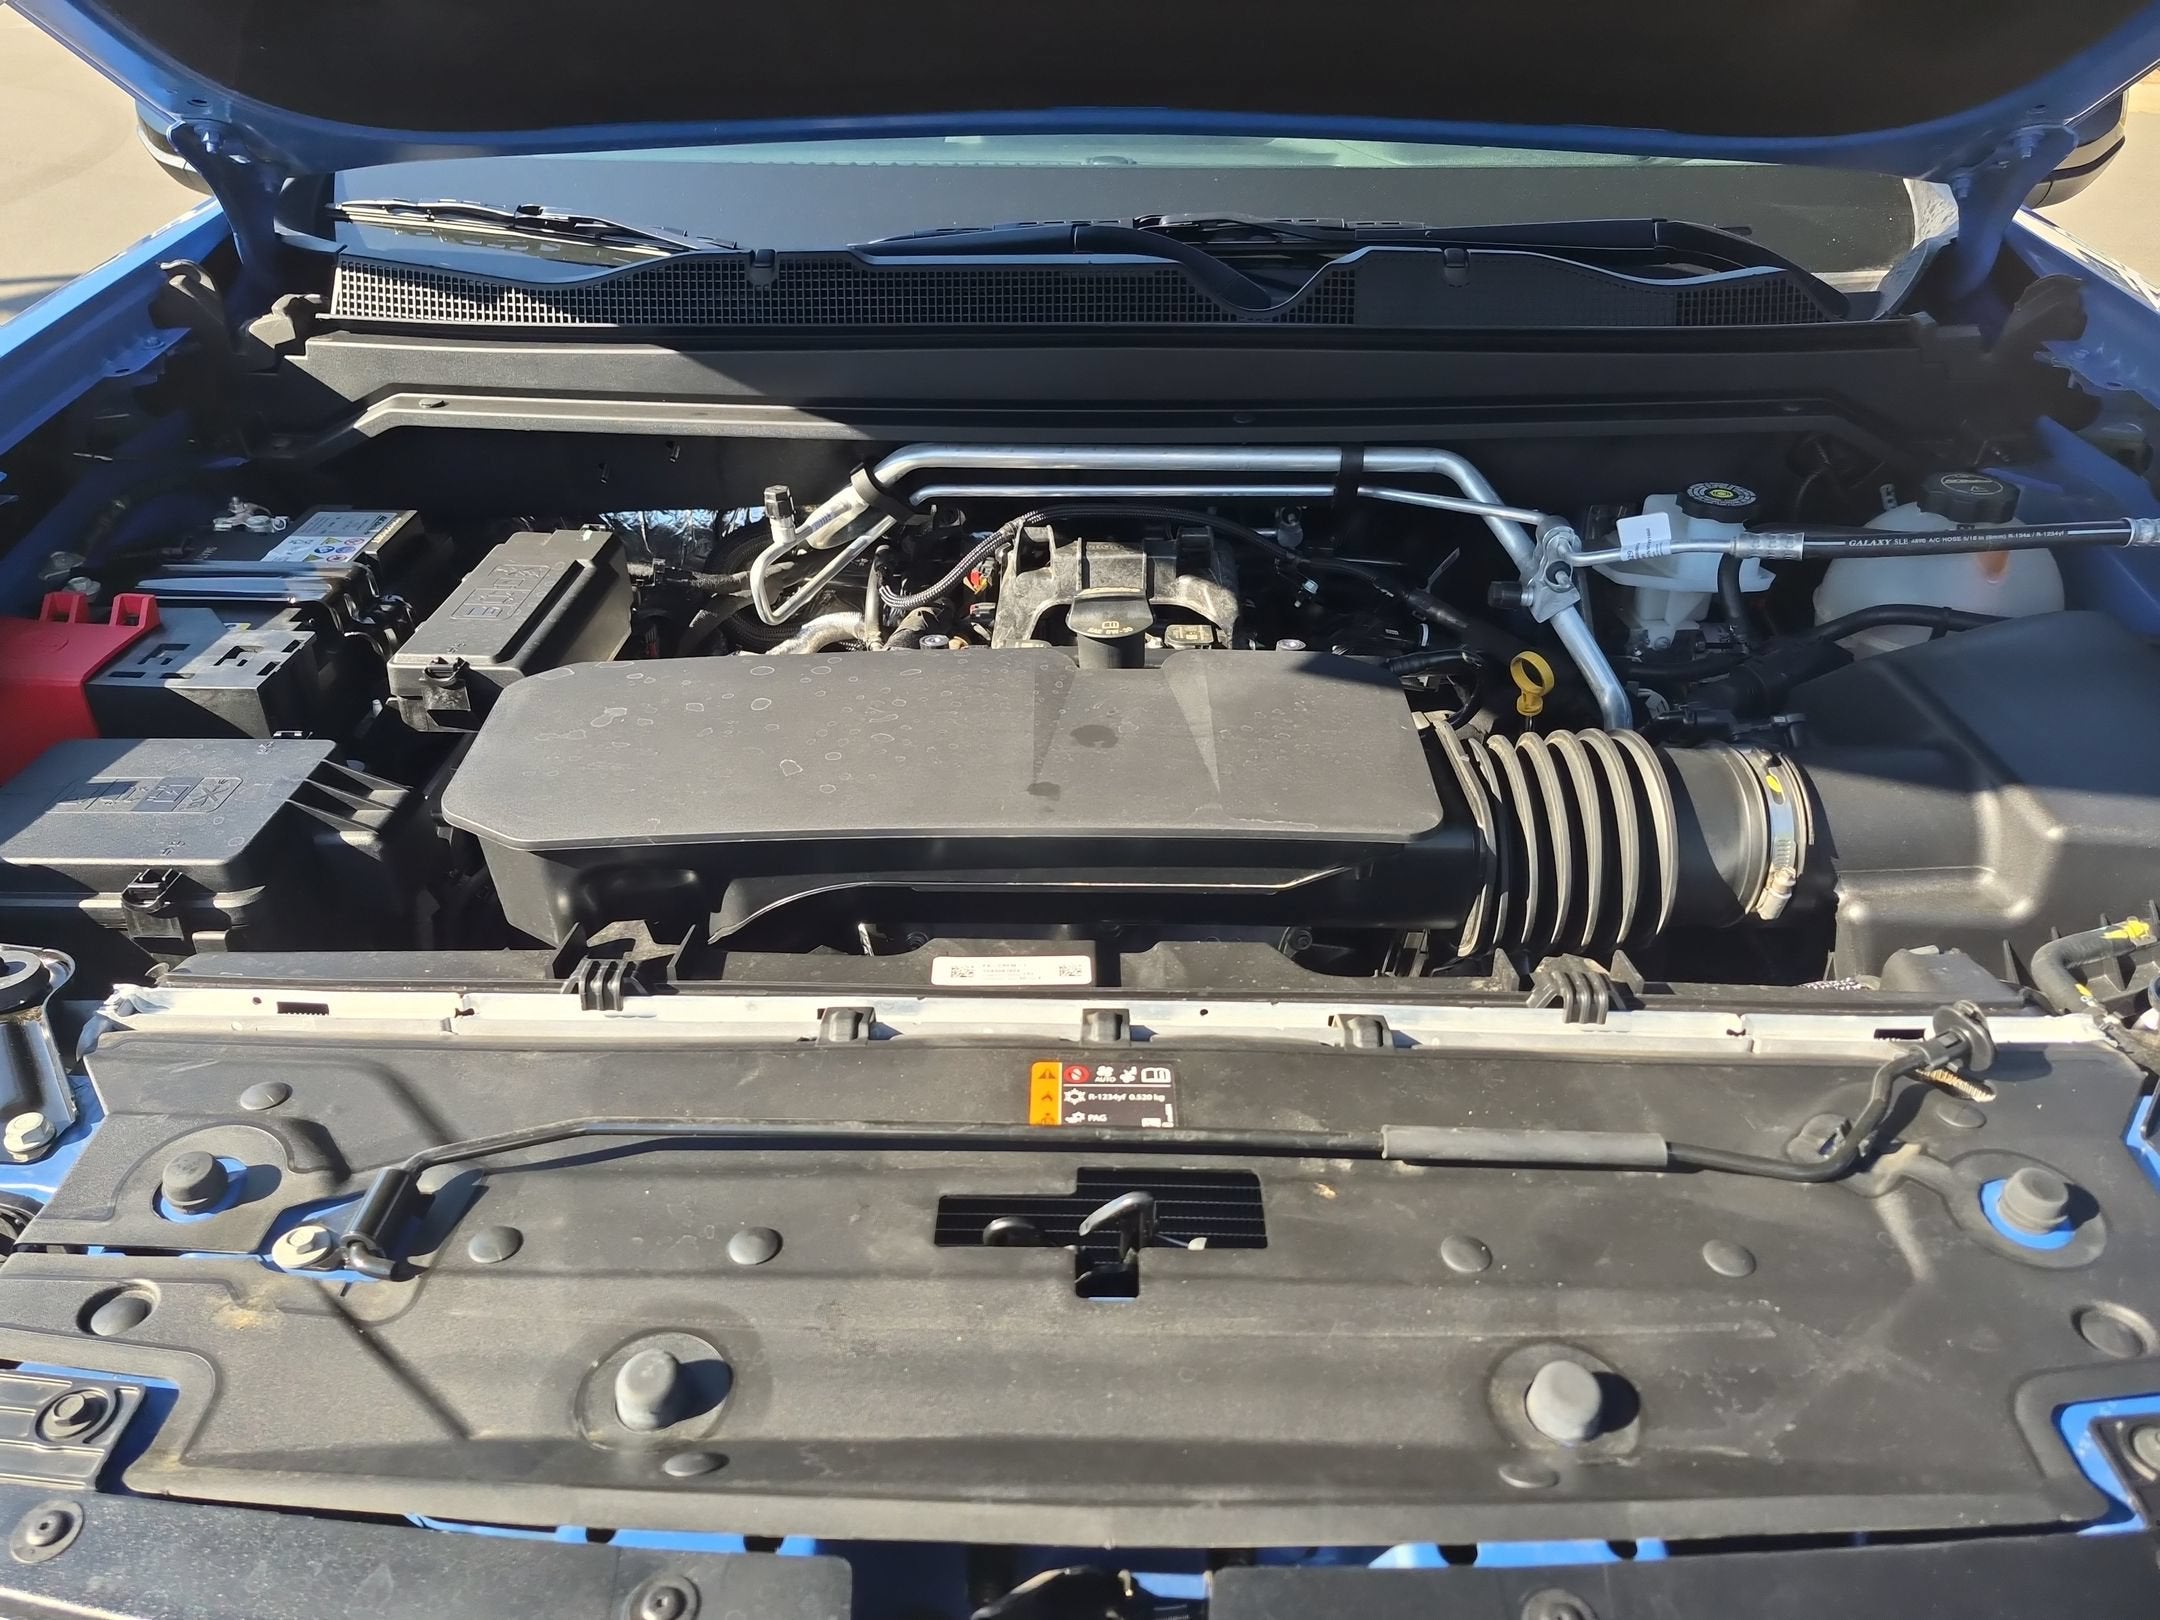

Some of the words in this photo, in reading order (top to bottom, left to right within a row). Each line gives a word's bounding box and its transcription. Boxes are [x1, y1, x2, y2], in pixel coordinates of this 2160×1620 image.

[1848, 539, 1892, 547] GALAXY
[1894, 538, 1909, 546] SLE
[1088, 1093, 1127, 1102] R-1234yf
[1128, 1093, 1153, 1101] 0.520
[1153, 1093, 1165, 1102] kg
[1087, 1113, 1108, 1122] PAG
